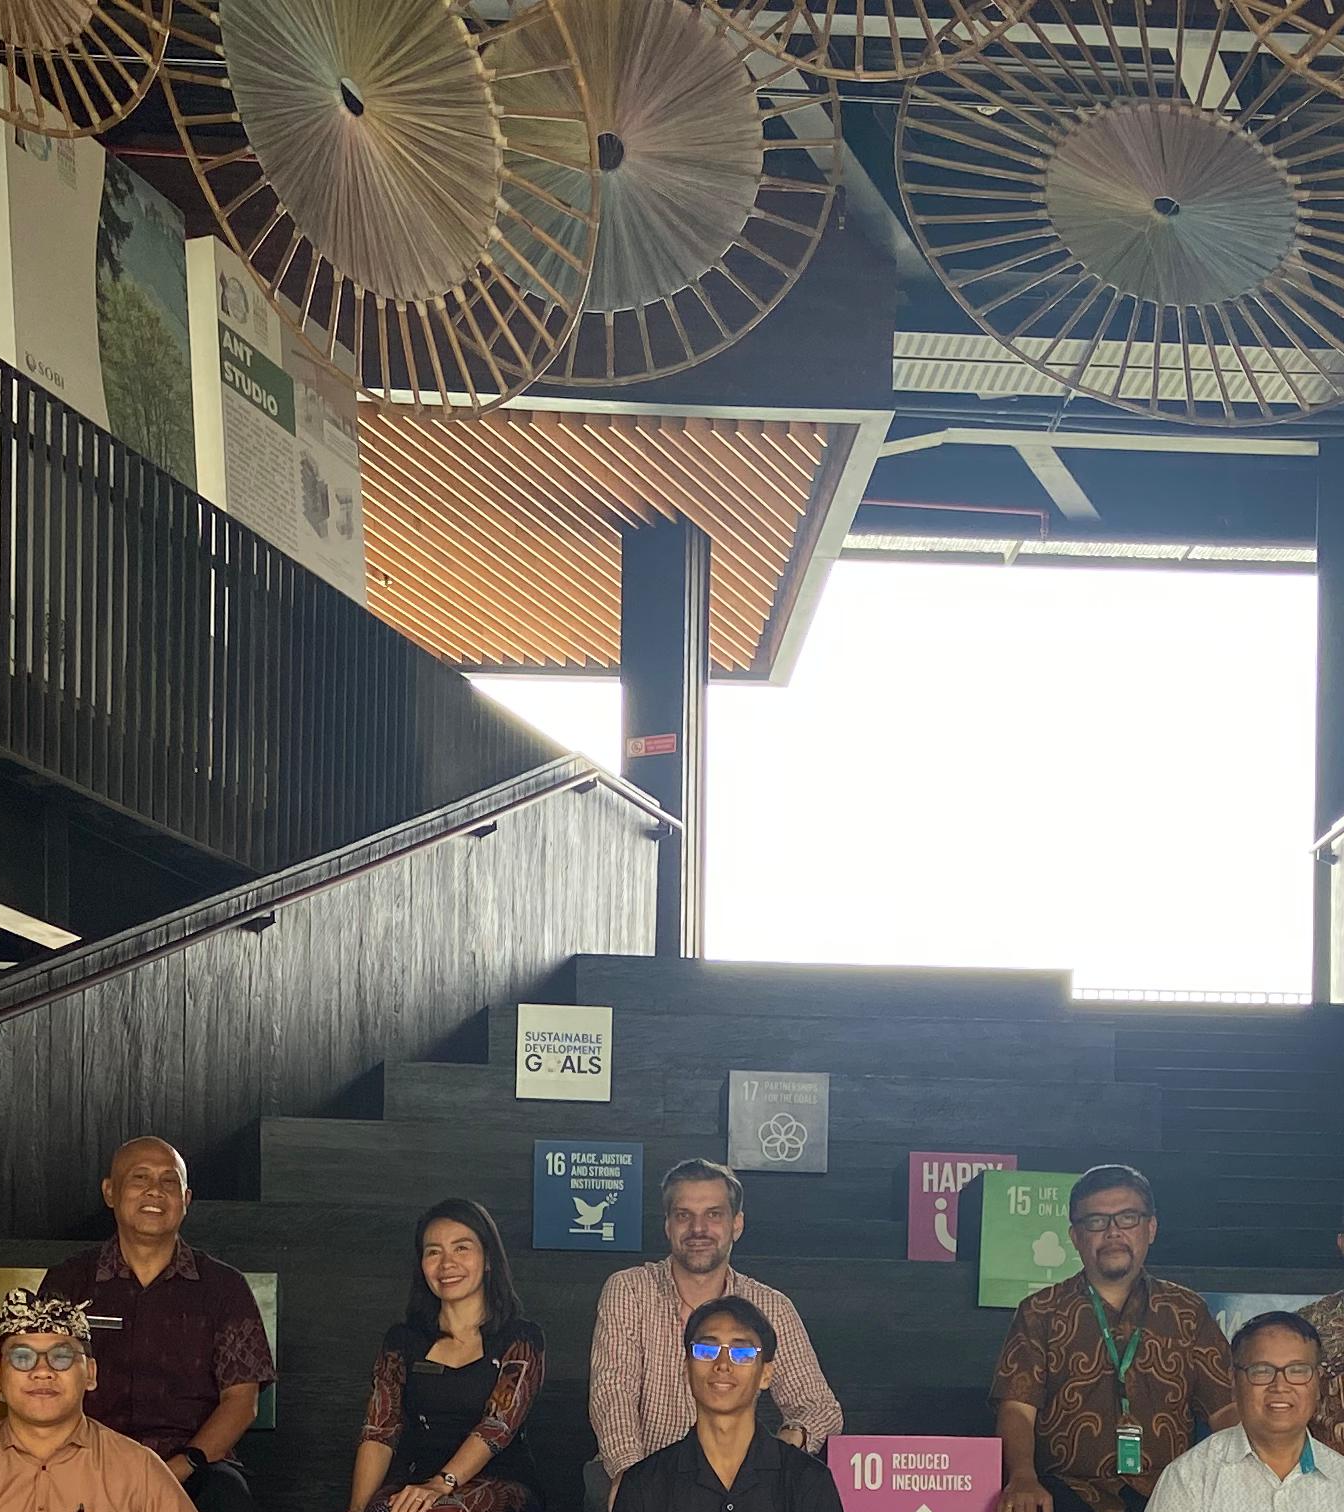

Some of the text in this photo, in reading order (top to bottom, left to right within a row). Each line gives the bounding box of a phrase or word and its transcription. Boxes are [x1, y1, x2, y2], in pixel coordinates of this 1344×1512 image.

[223, 330, 253, 367] ANT
[38, 362, 65, 389] SOBI
[224, 360, 279, 416] STUDIO
[524, 1031, 603, 1044] SUSTAINABLE
[524, 1043, 603, 1055] DEVELOPMENT
[524, 1053, 602, 1074] GALS
[743, 1081, 759, 1101] 17
[545, 1151, 566, 1176] 16
[599, 1153, 633, 1165] JUSTICE
[570, 1165, 621, 1177] AND STRONG
[570, 1178, 625, 1190] INSTITUTIONS
[922, 1162, 1004, 1193] HAP
[1007, 1186, 1057, 1216] 15 LIFE
[1038, 1204, 1070, 1217] ON LA
[849, 1452, 949, 1491] 10 REDUCED
[892, 1474, 972, 1492] INEQUALITIES
